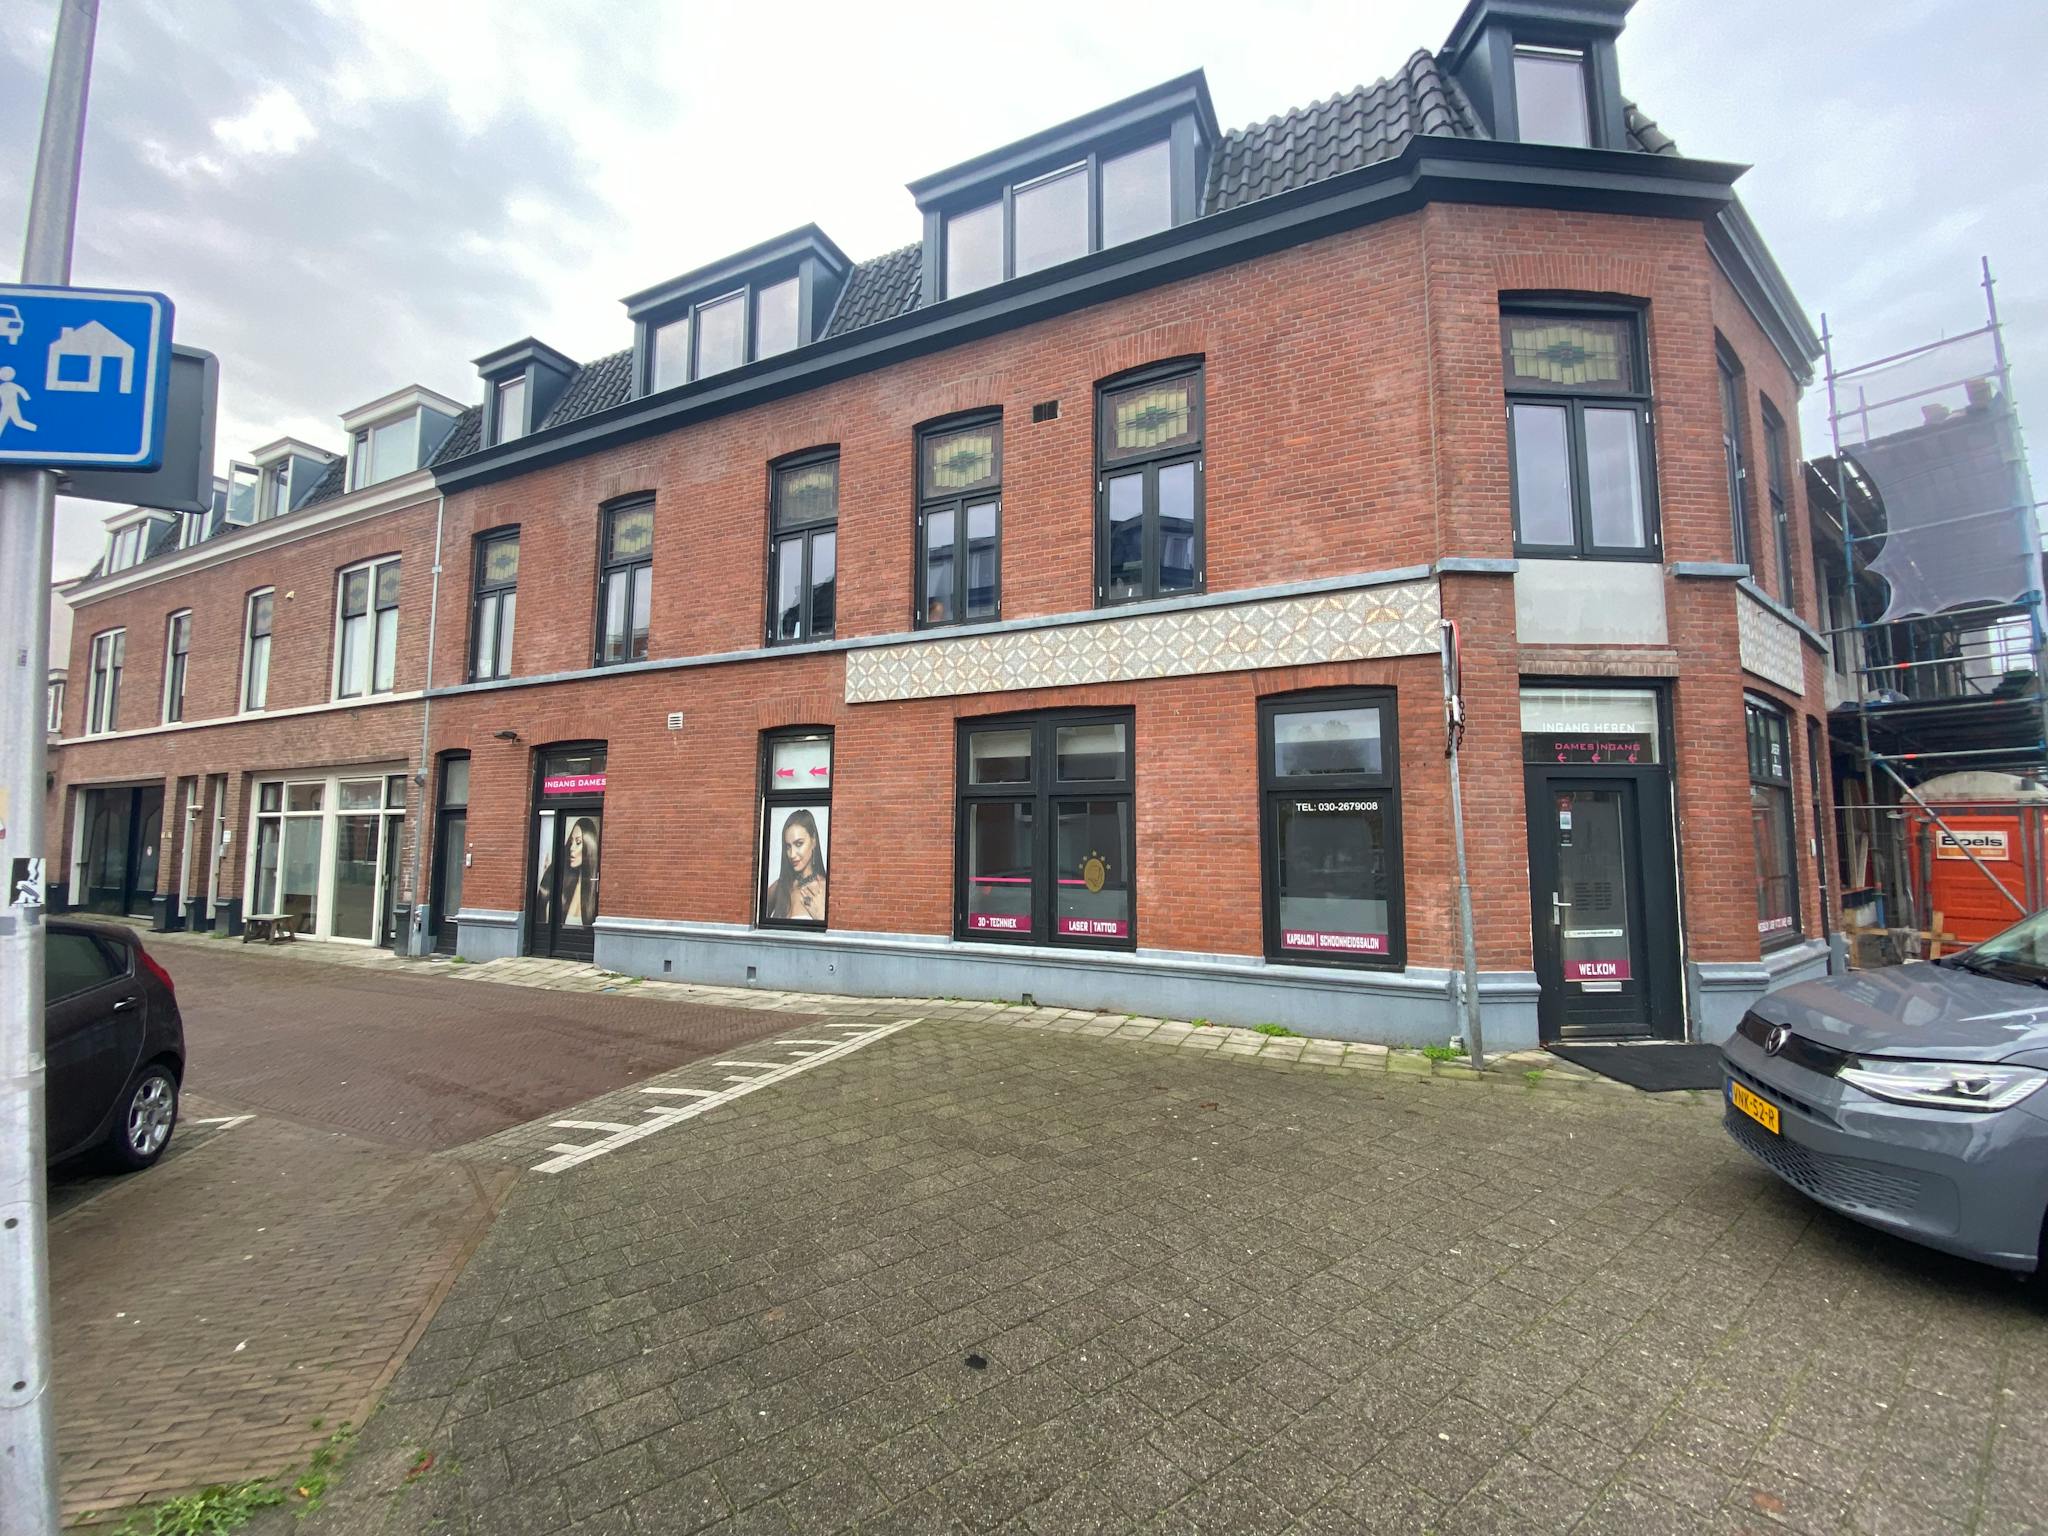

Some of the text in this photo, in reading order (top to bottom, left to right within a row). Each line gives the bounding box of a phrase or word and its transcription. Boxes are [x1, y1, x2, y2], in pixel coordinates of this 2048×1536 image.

[1542, 722, 1589, 733] INGANG
[1554, 742, 1641, 752] DAMES INGANG
[544, 778, 607, 788] INGANG DAMES
[1295, 801, 1378, 812] TEL: 030-2679008
[989, 918, 1017, 929] TECHNIEK
[1068, 920, 1088, 932] LASER
[1093, 922, 1117, 934] TATTOO
[1286, 933, 1315, 946] KAPSALON
[1319, 934, 1380, 950] SCHOONHEIDSSALON
[1578, 963, 1617, 976] WELKOM
[1734, 1084, 1775, 1129] VNK-52-R
